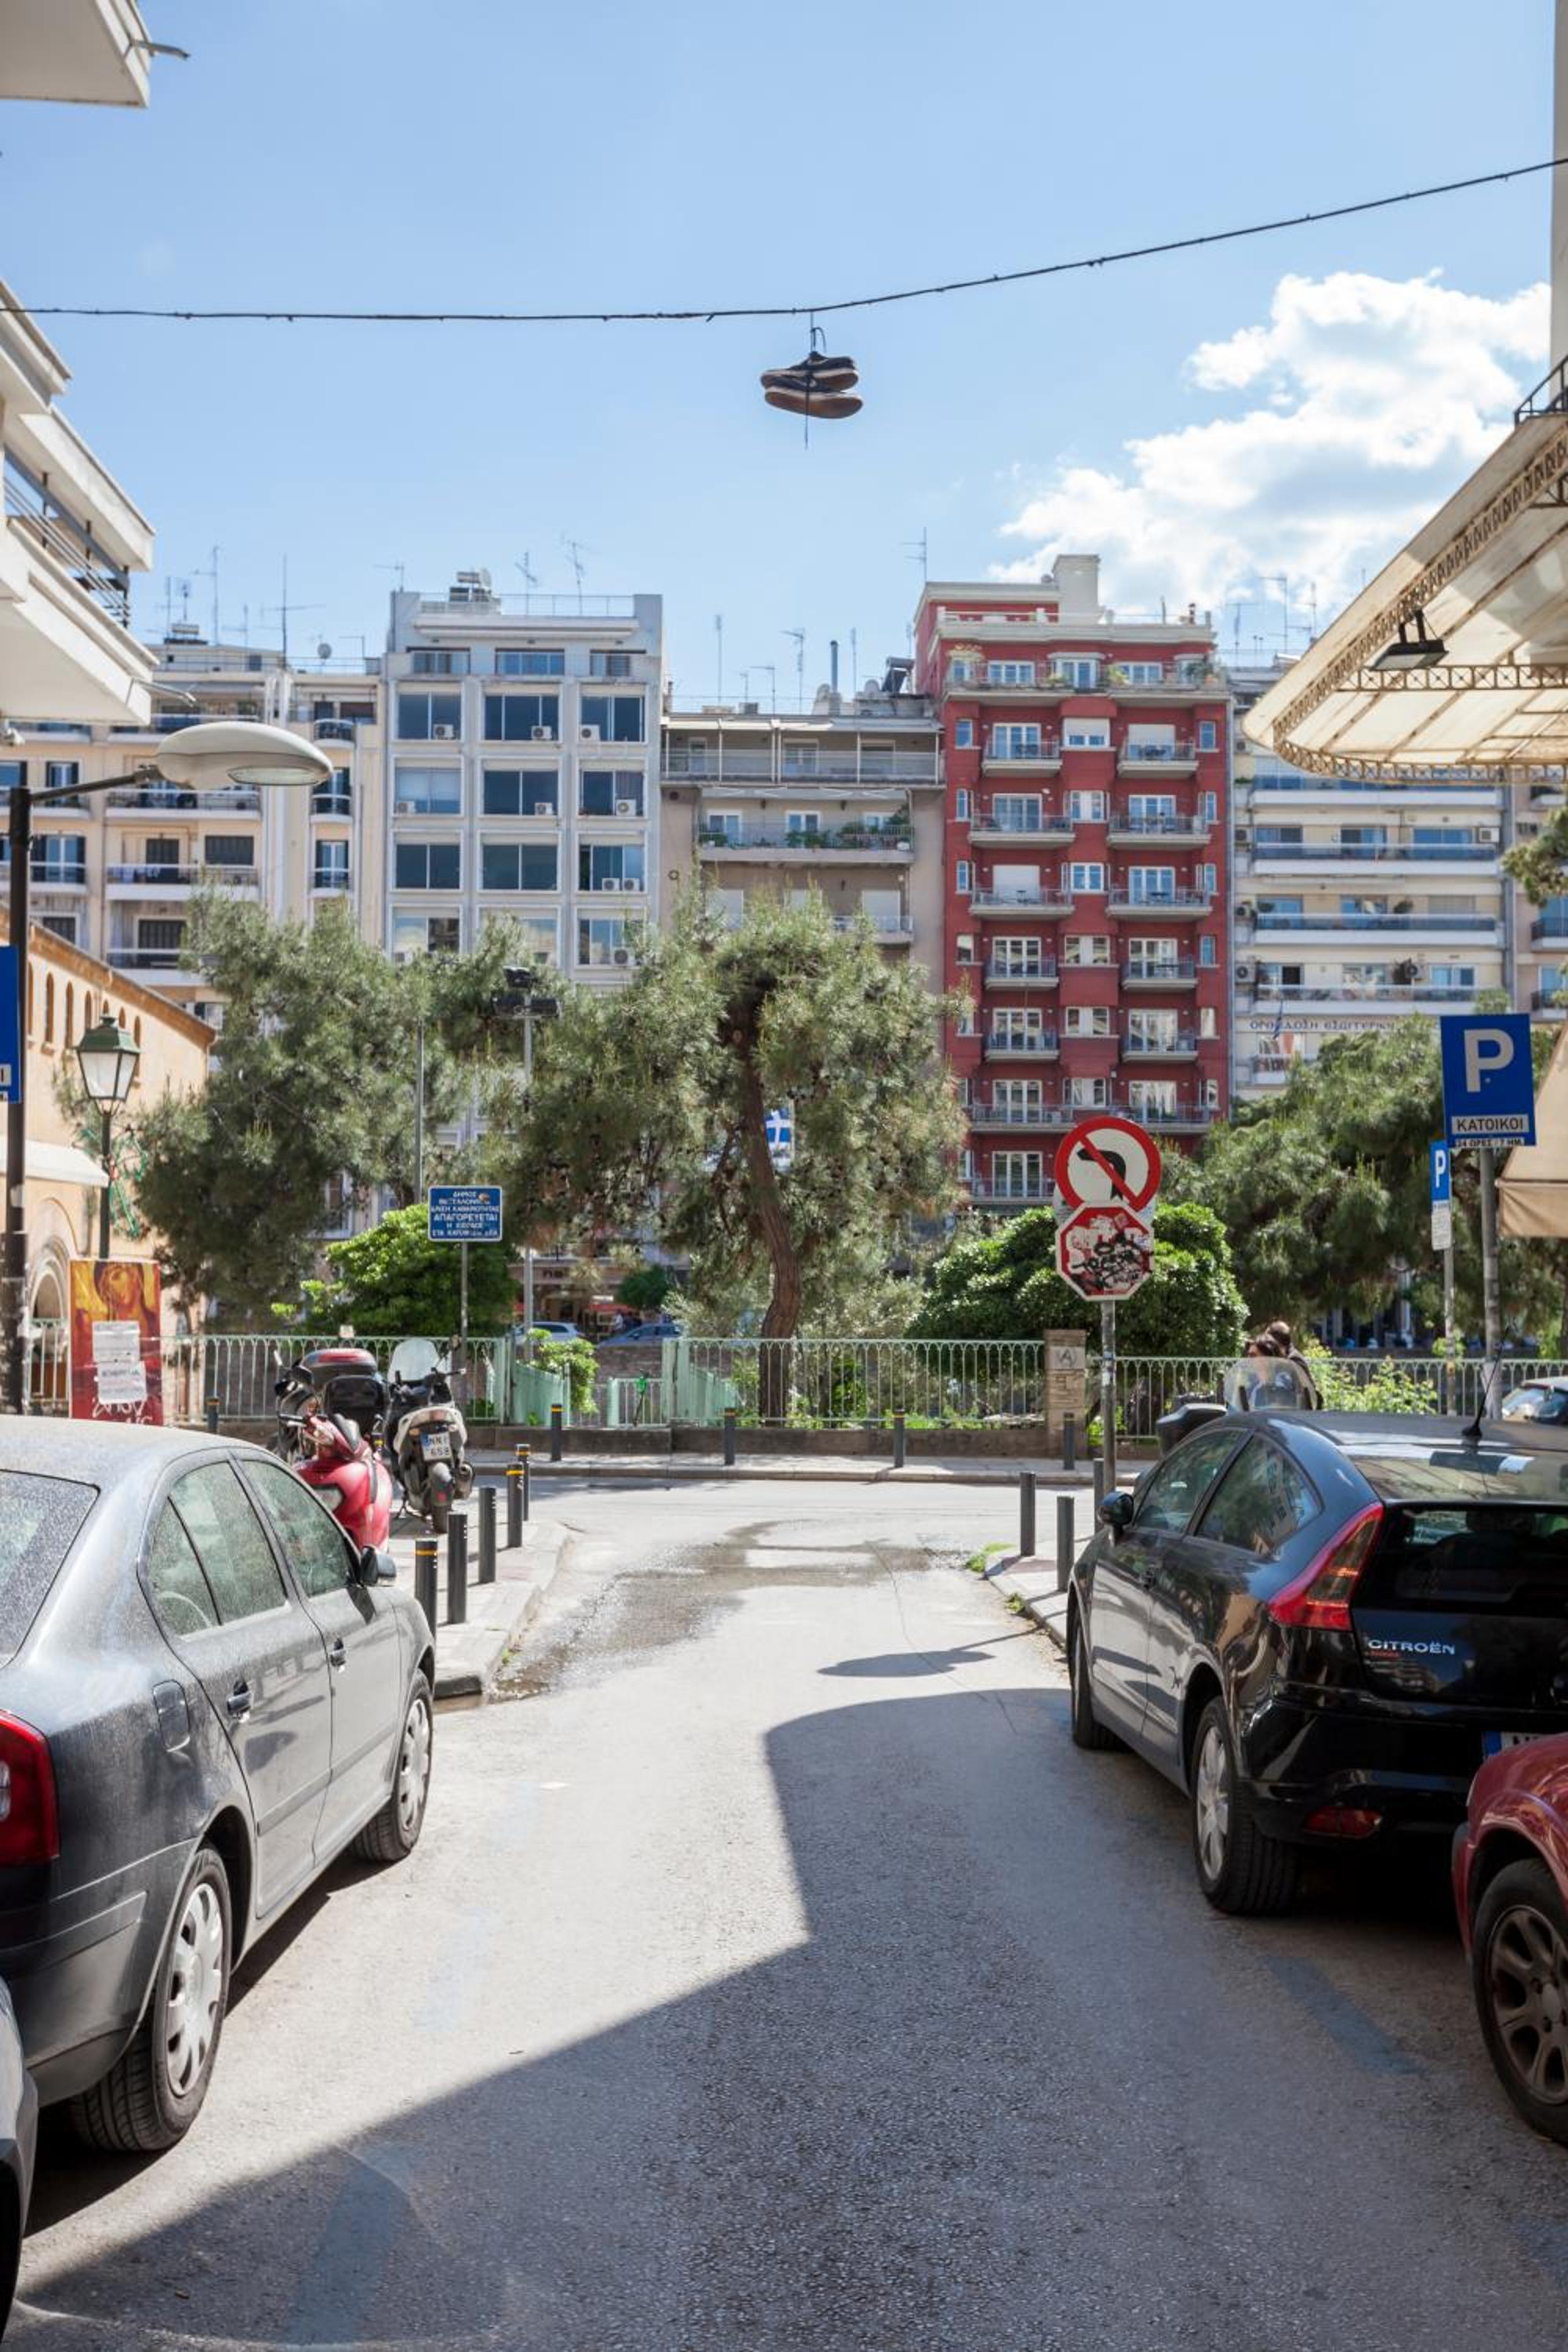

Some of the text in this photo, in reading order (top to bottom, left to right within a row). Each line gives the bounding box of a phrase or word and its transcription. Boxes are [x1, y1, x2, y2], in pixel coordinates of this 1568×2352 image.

[1464, 1029, 1514, 1093] P
[1457, 1117, 1523, 1131] ΚΑΤΟΙΚΟΙ
[1436, 1149, 1446, 1188] P
[434, 1213, 498, 1221] ΑΠΑΓΟΡΕΥΕΤΑΙ
[1368, 1639, 1456, 1654] CITROËN
